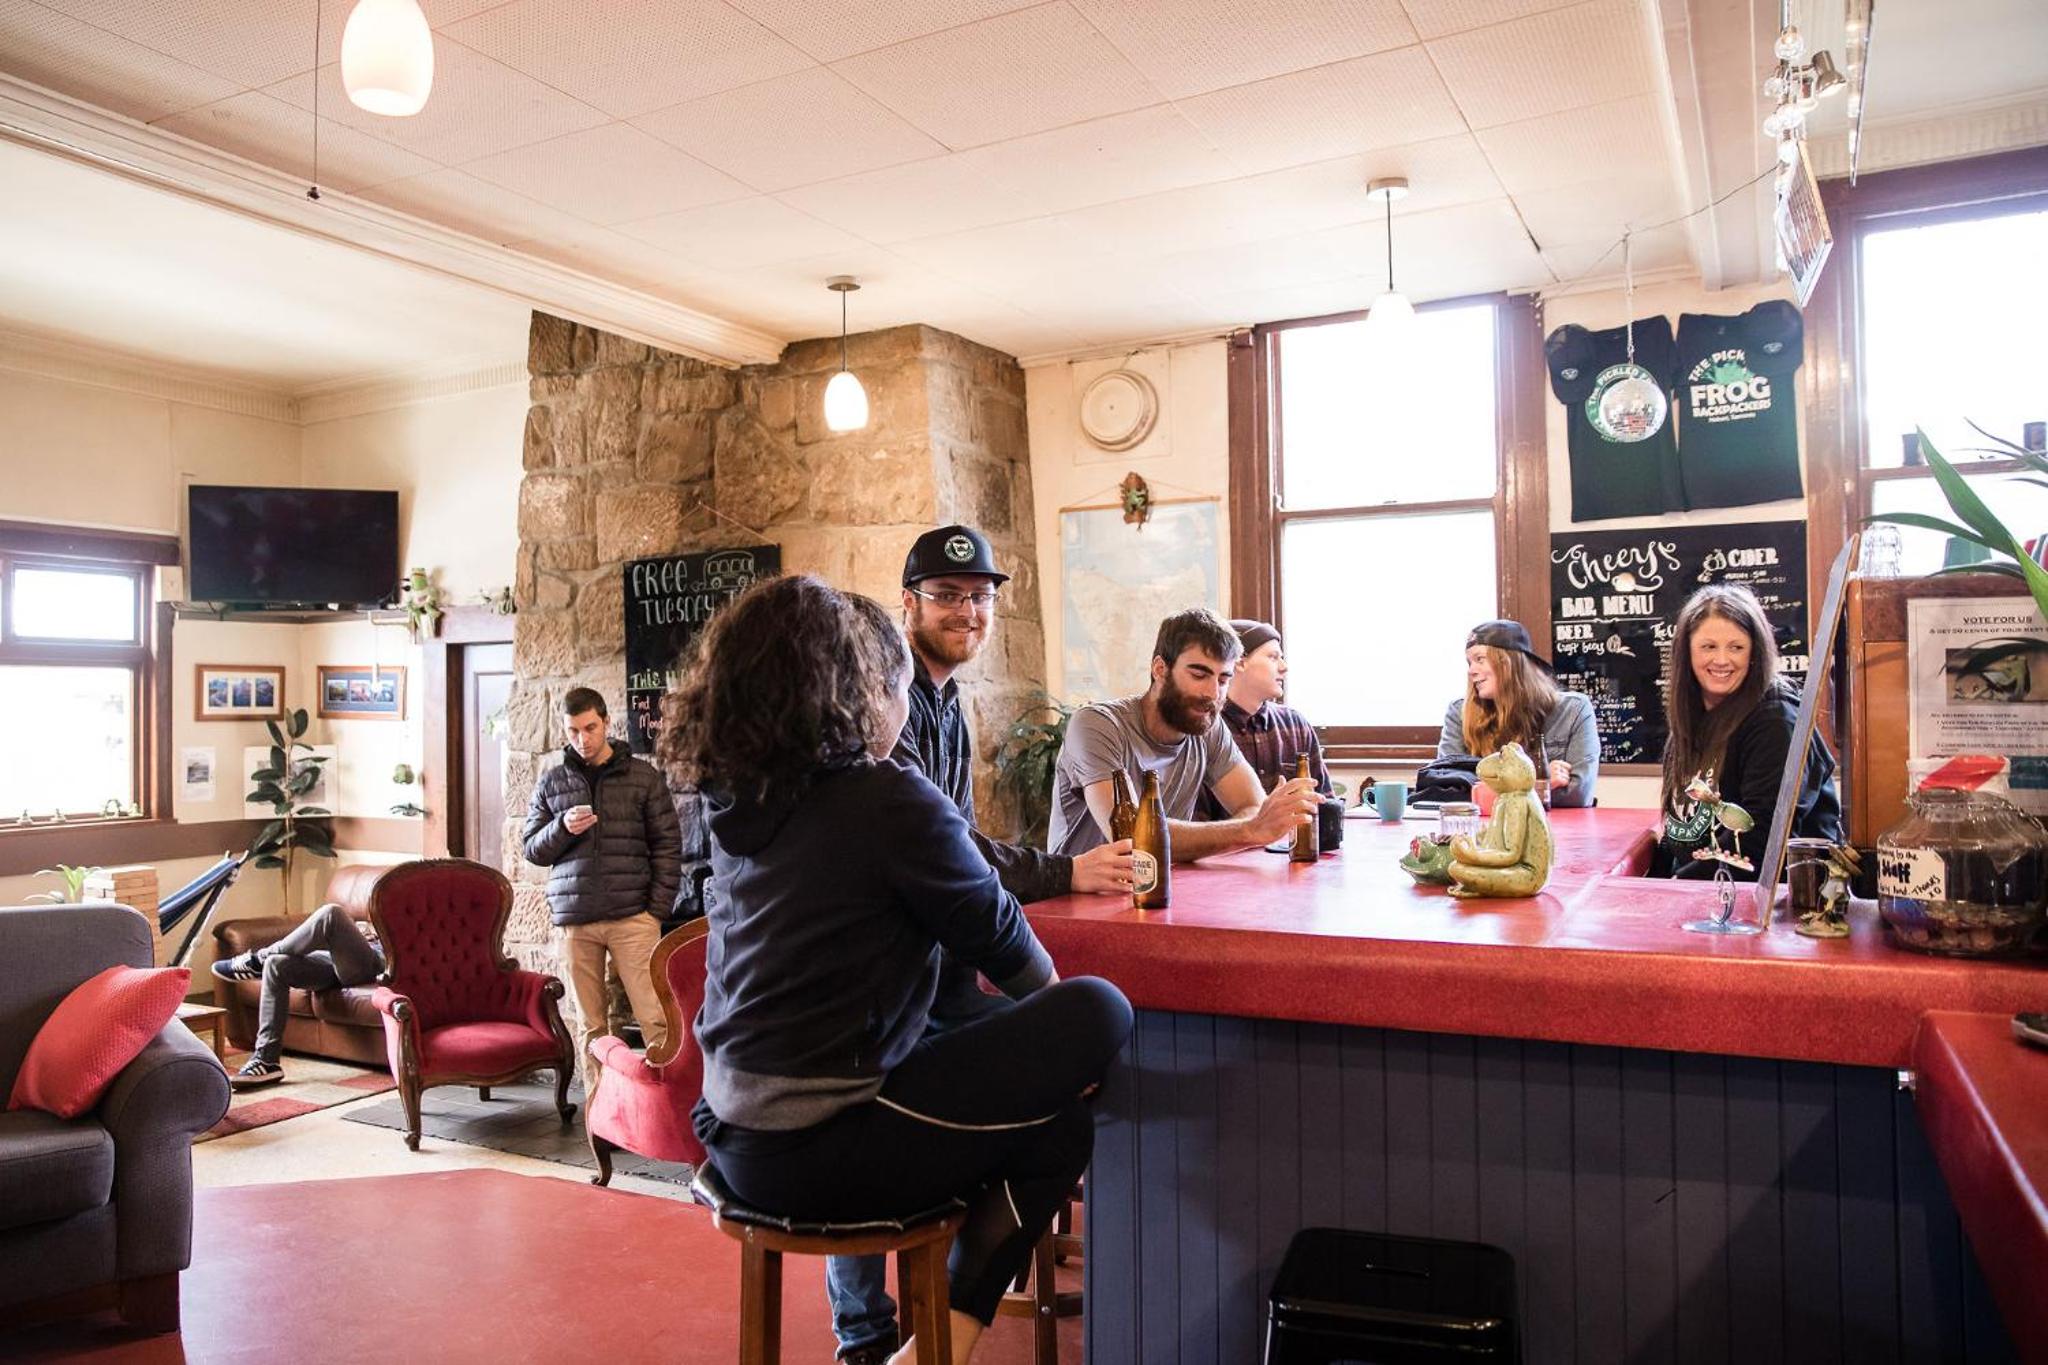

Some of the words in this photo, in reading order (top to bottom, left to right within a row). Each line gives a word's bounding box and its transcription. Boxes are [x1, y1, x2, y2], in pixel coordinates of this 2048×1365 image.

[1688, 359, 1711, 382] THE
[1711, 349, 1746, 363] PICK
[1690, 376, 1771, 407] FROG
[1692, 398, 1772, 418] BACKPACKERS
[1727, 547, 1779, 568] CIDER
[1561, 597, 1597, 618] BAR
[1602, 594, 1654, 616] MENU
[1962, 616, 1993, 626] VOTE
[1994, 616, 2016, 625] FOR
[2018, 615, 2033, 624] US
[1556, 624, 1594, 641] BEER
